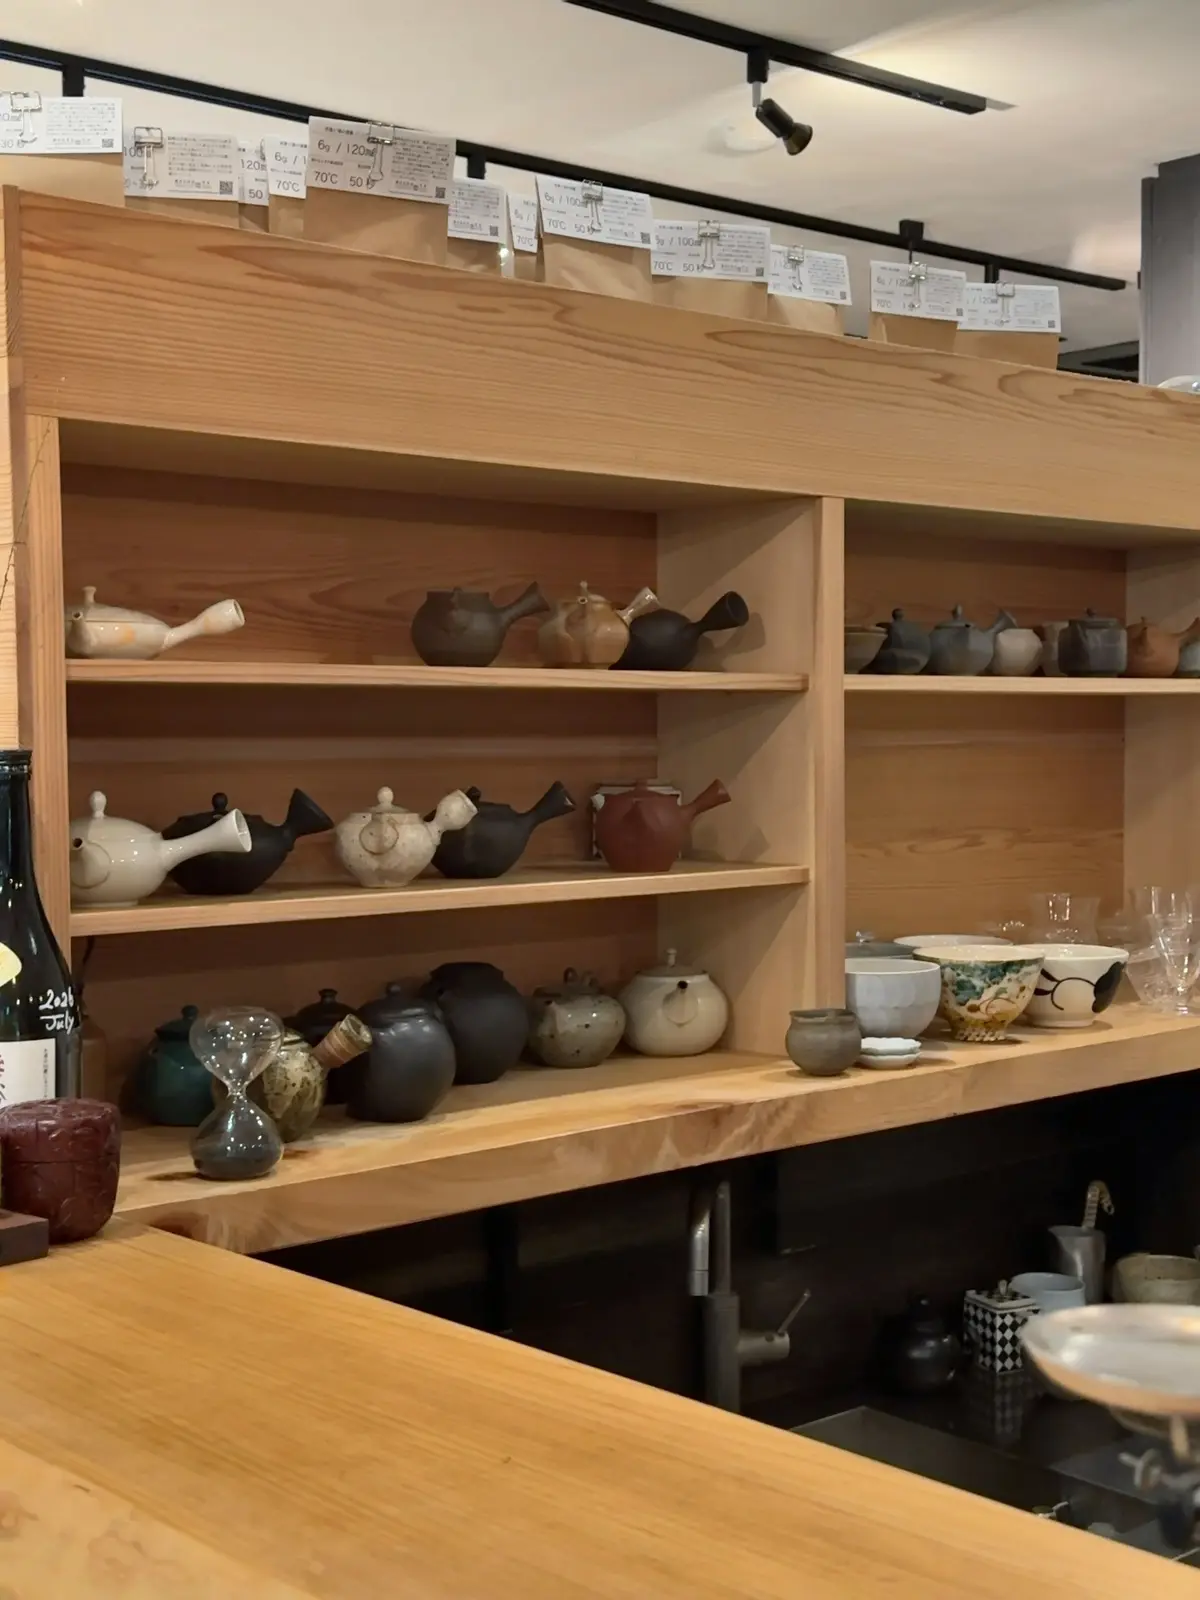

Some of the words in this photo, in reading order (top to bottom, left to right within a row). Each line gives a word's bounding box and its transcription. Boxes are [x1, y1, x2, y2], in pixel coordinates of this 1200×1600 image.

[317, 139, 330, 153] 6g
[336, 142, 342, 153] /
[274, 152, 288, 164] 6g
[293, 155, 298, 165] /
[349, 176, 363, 187] 50
[248, 189, 263, 200] 50
[574, 223, 585, 233] 50
[683, 262, 695, 272] 50
[39, 1010, 75, 1035] July
